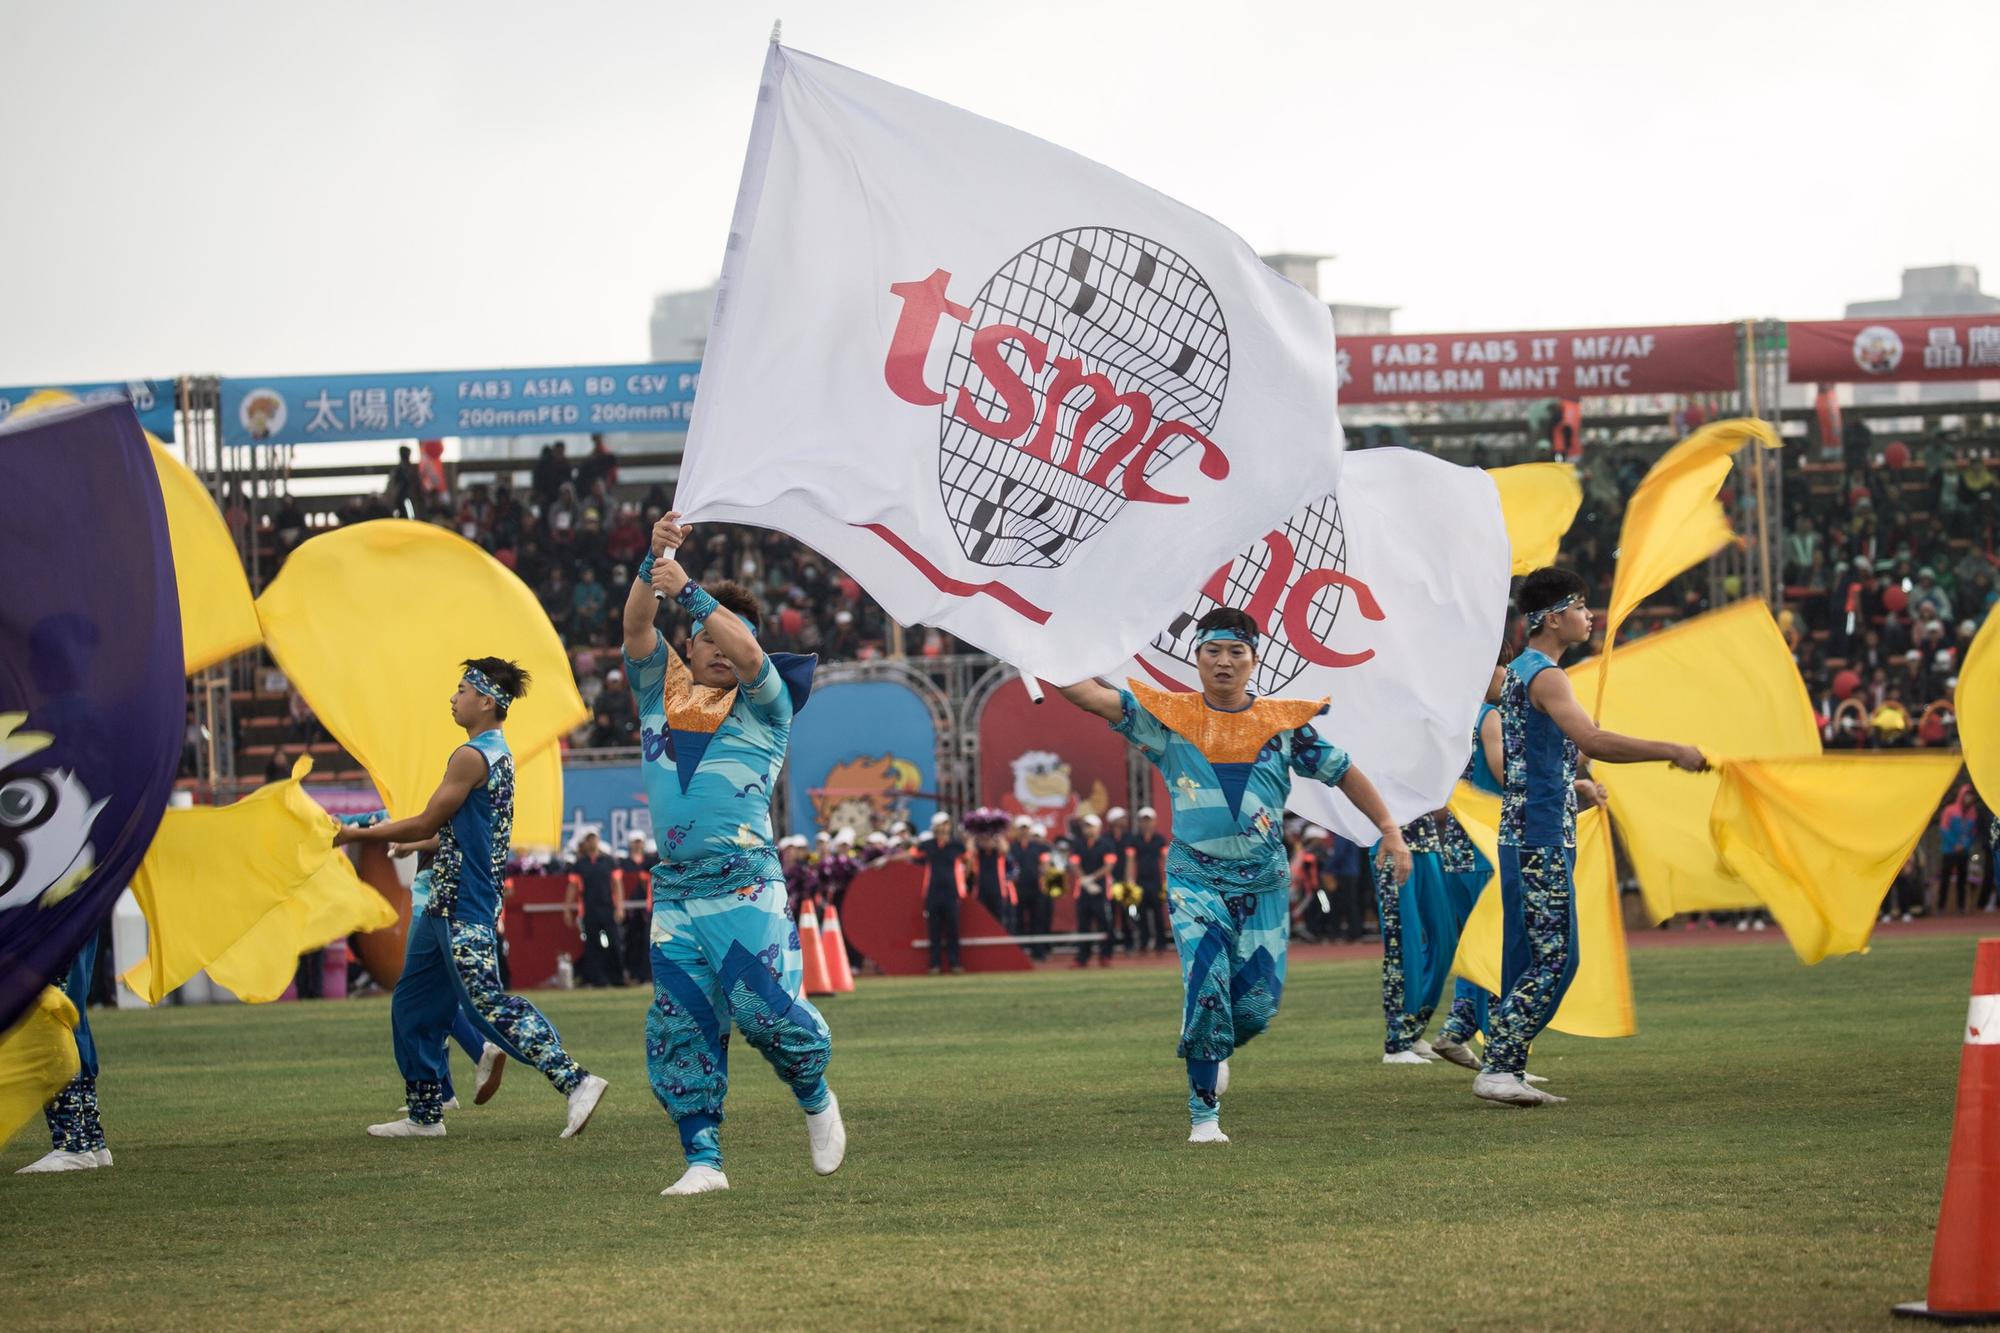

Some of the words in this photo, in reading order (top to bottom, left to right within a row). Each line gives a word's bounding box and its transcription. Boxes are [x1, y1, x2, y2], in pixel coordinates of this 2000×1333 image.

[1371, 343, 1438, 366] FAB2
[1531, 337, 1558, 361] IT
[1571, 334, 1655, 360] MF/AF
[458, 380, 512, 399] FAB3
[523, 378, 574, 397] ASIA
[585, 376, 616, 396] BD
[627, 374, 668, 395] CSV
[885, 268, 1230, 504] tsmc
[1372, 369, 1485, 395] MM&RM
[1499, 366, 1560, 390] MNT
[1573, 363, 1631, 388] MTC
[304, 384, 434, 432] 太陽隊
